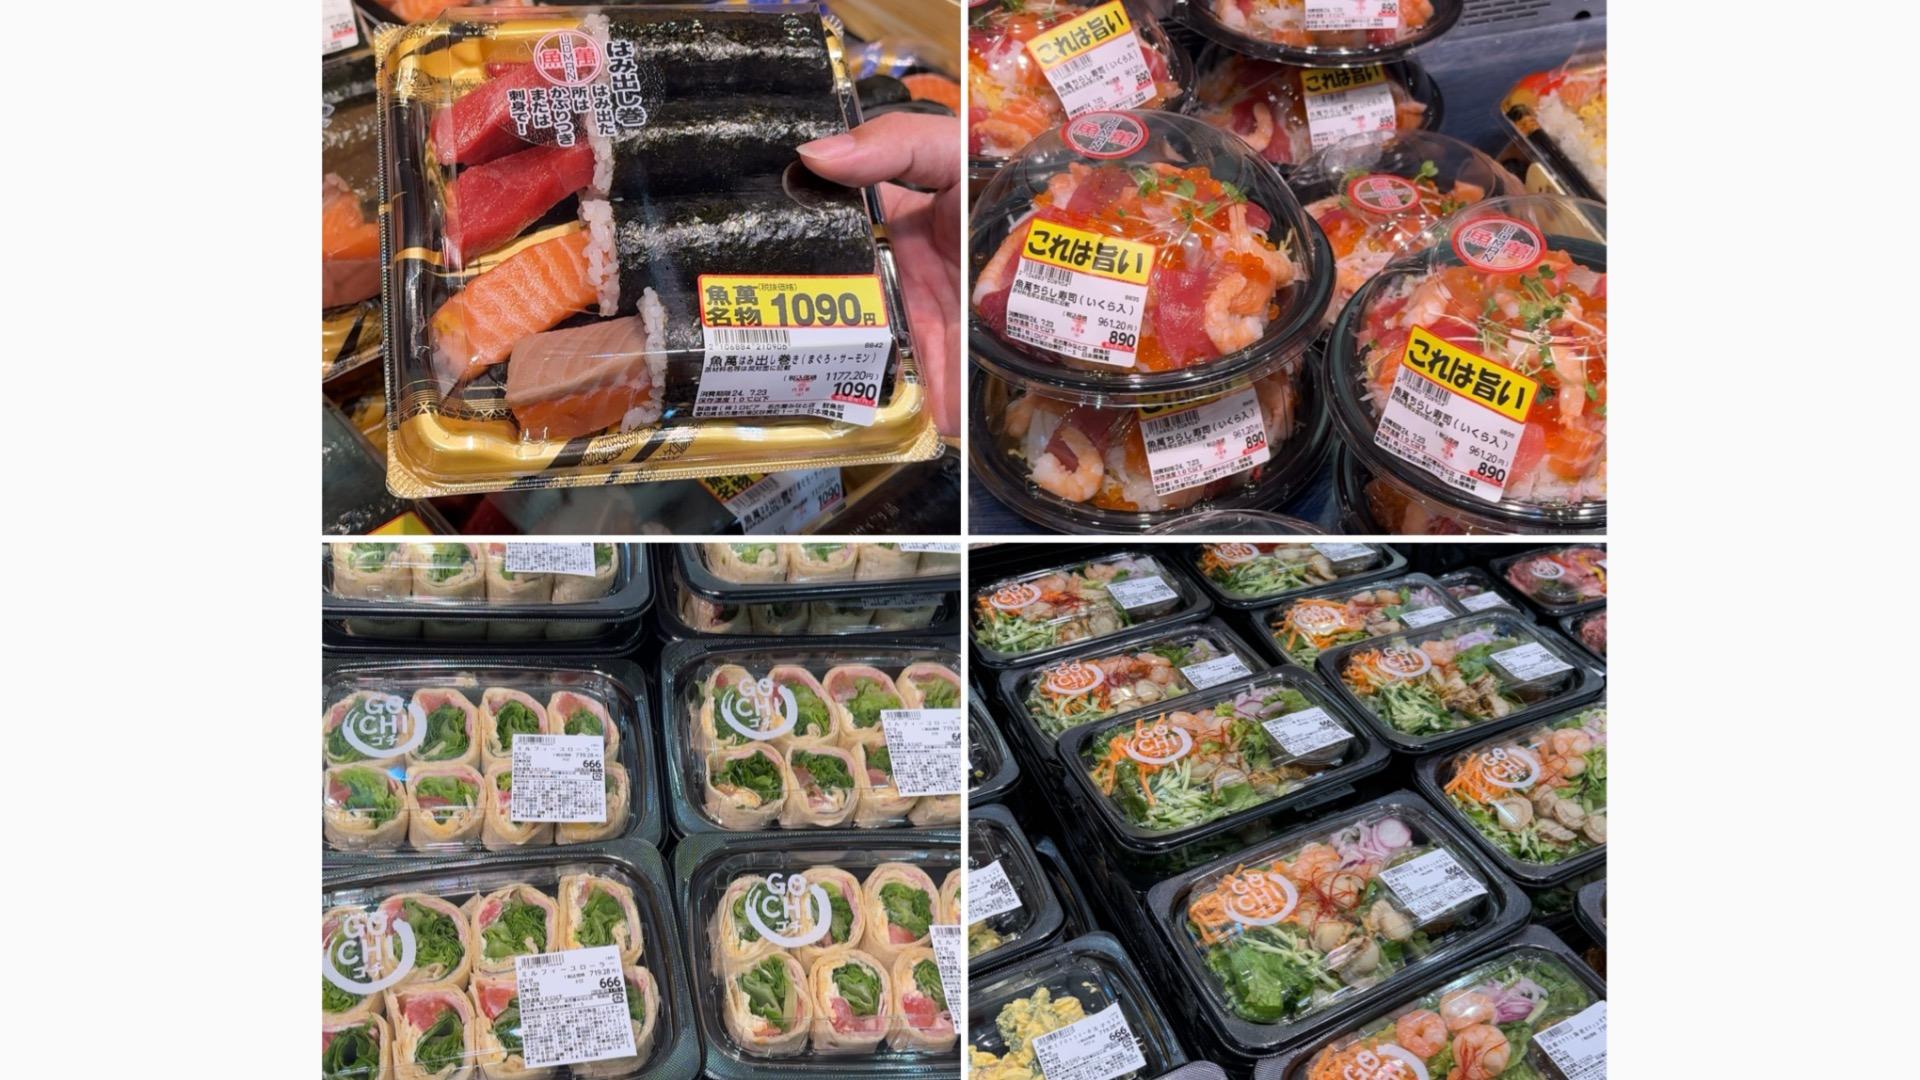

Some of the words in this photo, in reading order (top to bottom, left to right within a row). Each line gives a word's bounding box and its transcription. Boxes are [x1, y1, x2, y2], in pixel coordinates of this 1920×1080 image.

[1036, 9, 1125, 65] これは旨い
[606, 41, 647, 127] はみ出し巻
[530, 88, 551, 128] または
[571, 87, 590, 112] 所は
[508, 89, 530, 135] 刺身で!
[550, 87, 576, 146] かぶりつき
[592, 86, 616, 136] はみ出た
[1028, 229, 1144, 275] これは旨い
[705, 285, 759, 305] 魚萬
[705, 306, 763, 327] 名物
[1109, 329, 1136, 348] 890
[1408, 337, 1526, 410] これは旨い
[832, 382, 878, 402] 1090
[1245, 430, 1265, 450] 890
[1477, 461, 1506, 483] 890
[738, 677, 774, 698] GO
[365, 691, 405, 714] GO
[736, 697, 781, 717] CHI
[359, 715, 408, 735] CHI
[1140, 724, 1168, 739] GO
[1139, 734, 1178, 752] CHI
[583, 759, 602, 769] 666
[766, 872, 807, 897] GO
[762, 895, 812, 919] CHI
[343, 911, 388, 938] GO
[338, 935, 394, 965] CHI
[599, 976, 622, 990] 666
[1108, 1026, 1127, 1041] 666
